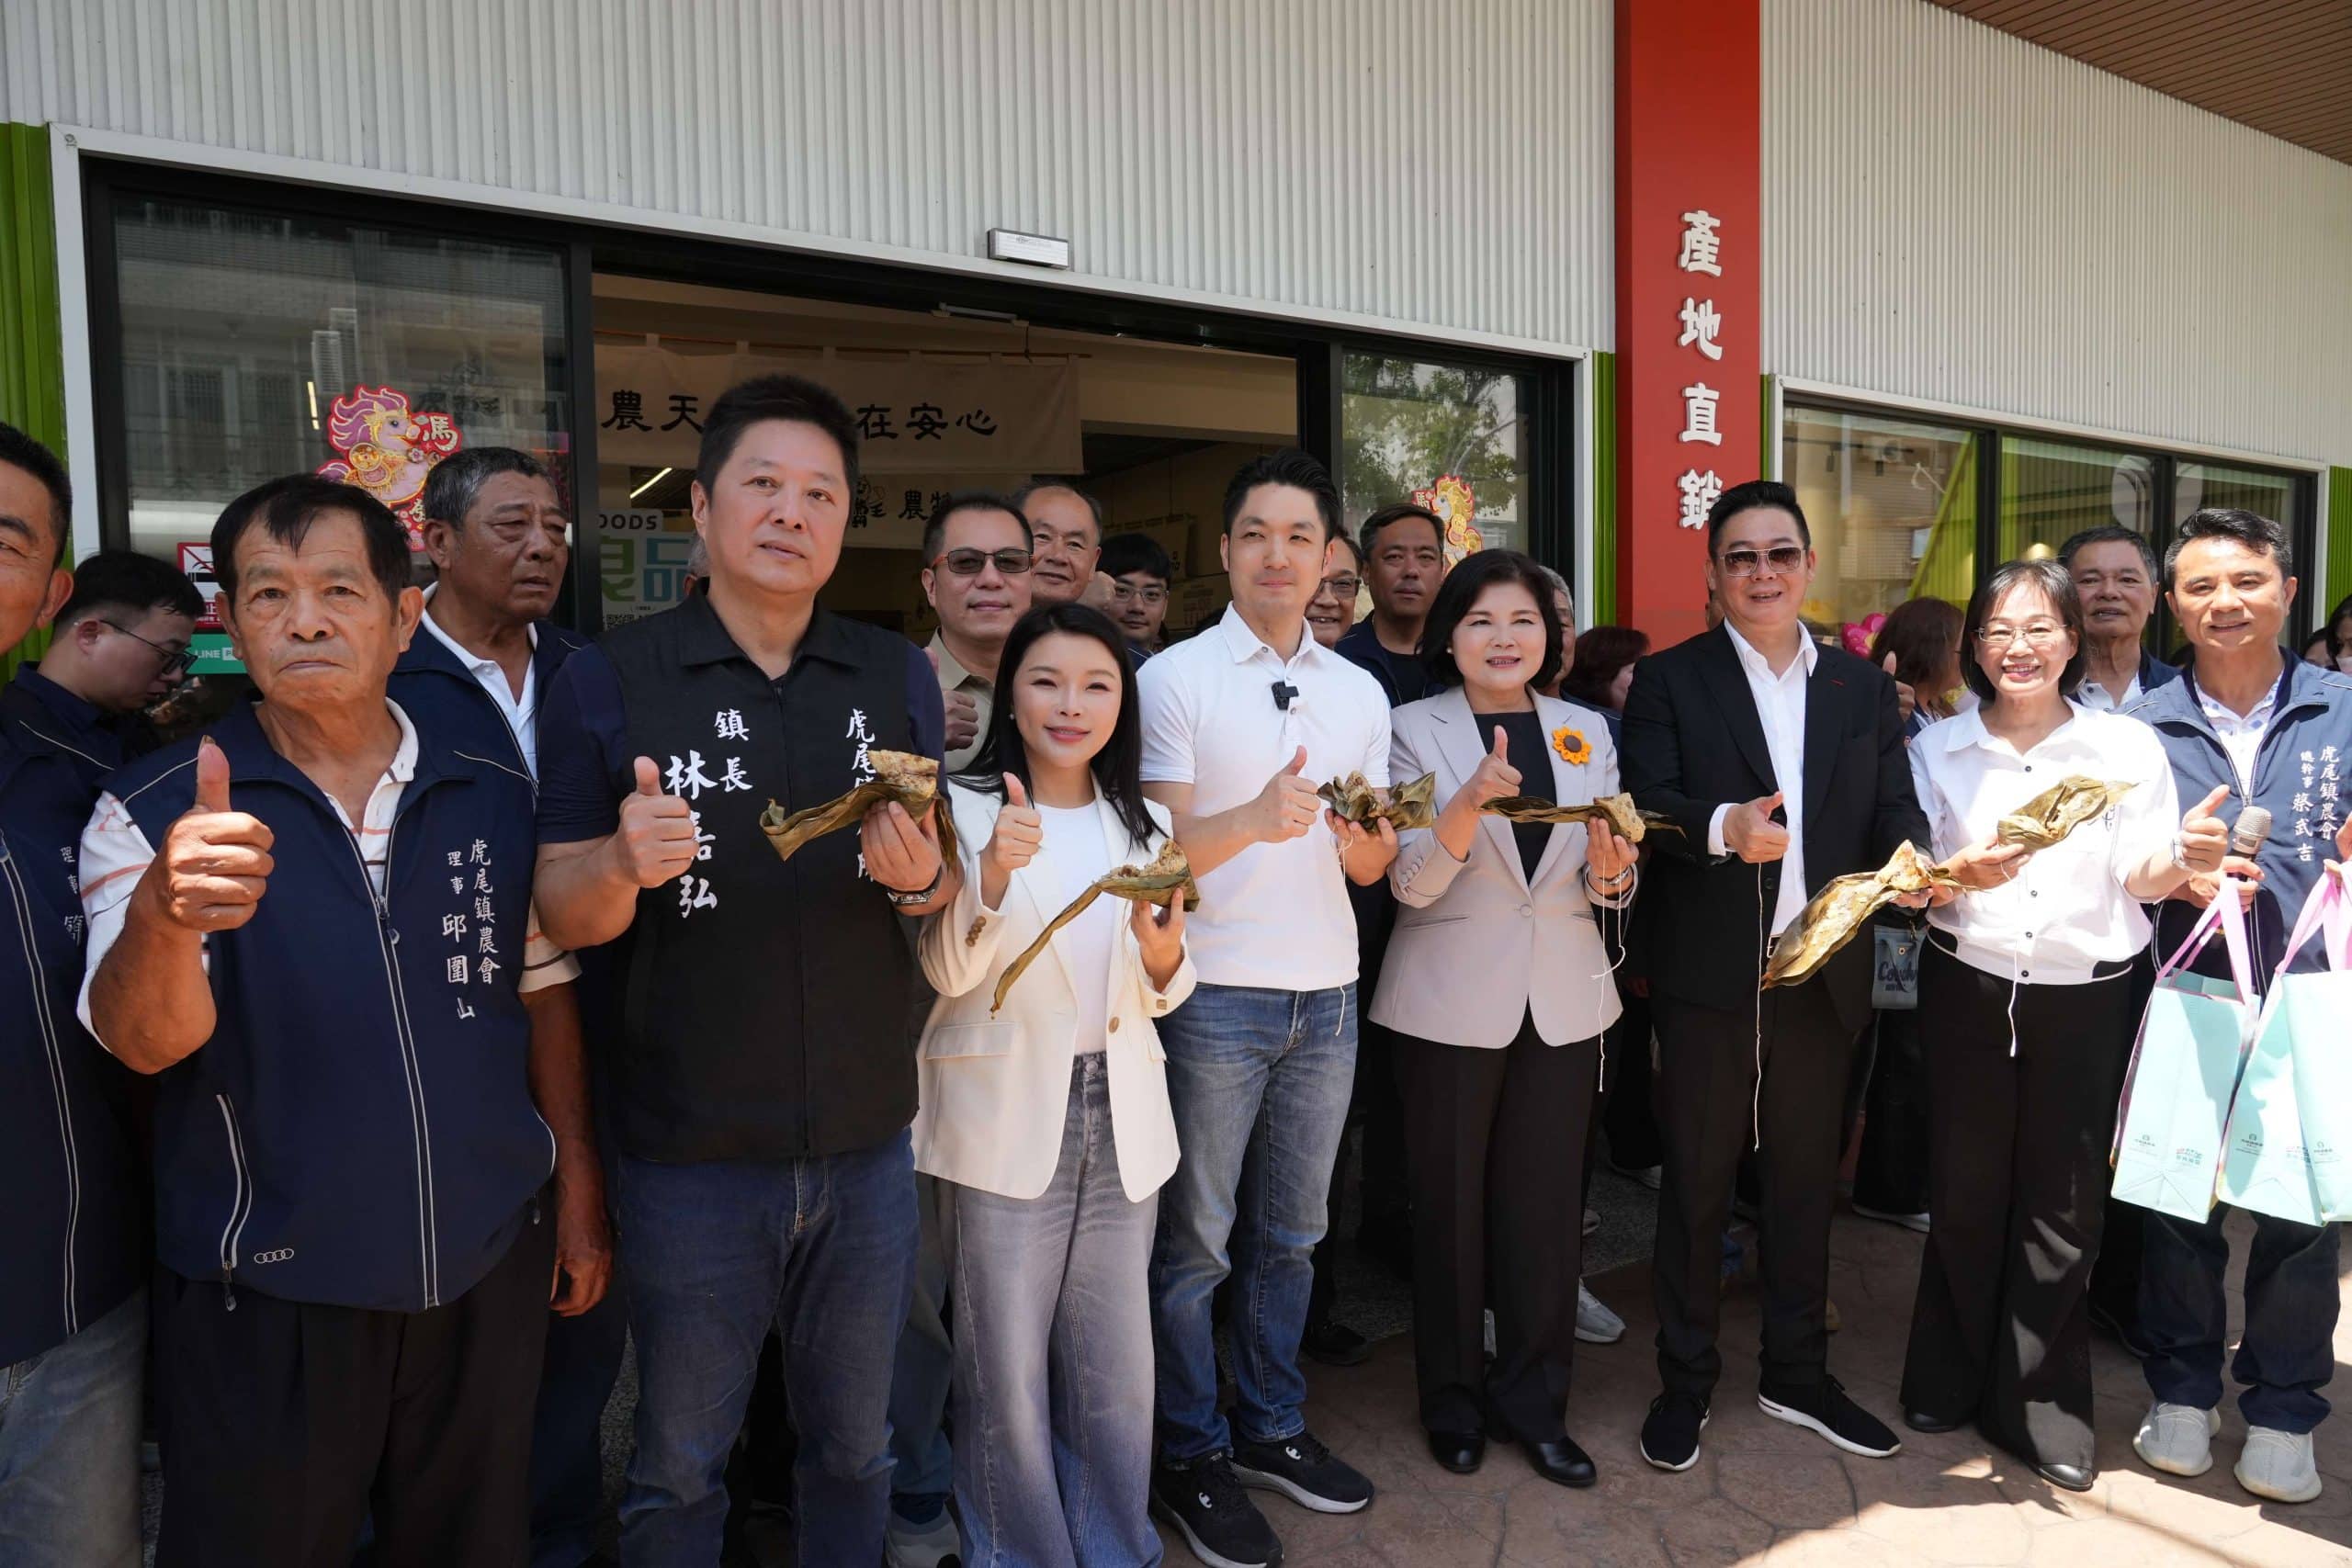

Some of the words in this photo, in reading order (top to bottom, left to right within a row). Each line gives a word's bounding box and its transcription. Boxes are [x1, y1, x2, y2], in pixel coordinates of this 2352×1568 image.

[1678, 209, 1723, 530] 產地直銷
[714, 708, 753, 793] 鎮長
[2320, 745, 2340, 841] 虎尾鎮農會
[2292, 792, 2314, 862] 蔡武吉
[447, 850, 464, 895] 理事
[469, 838, 502, 985] 虎尾鎮農會
